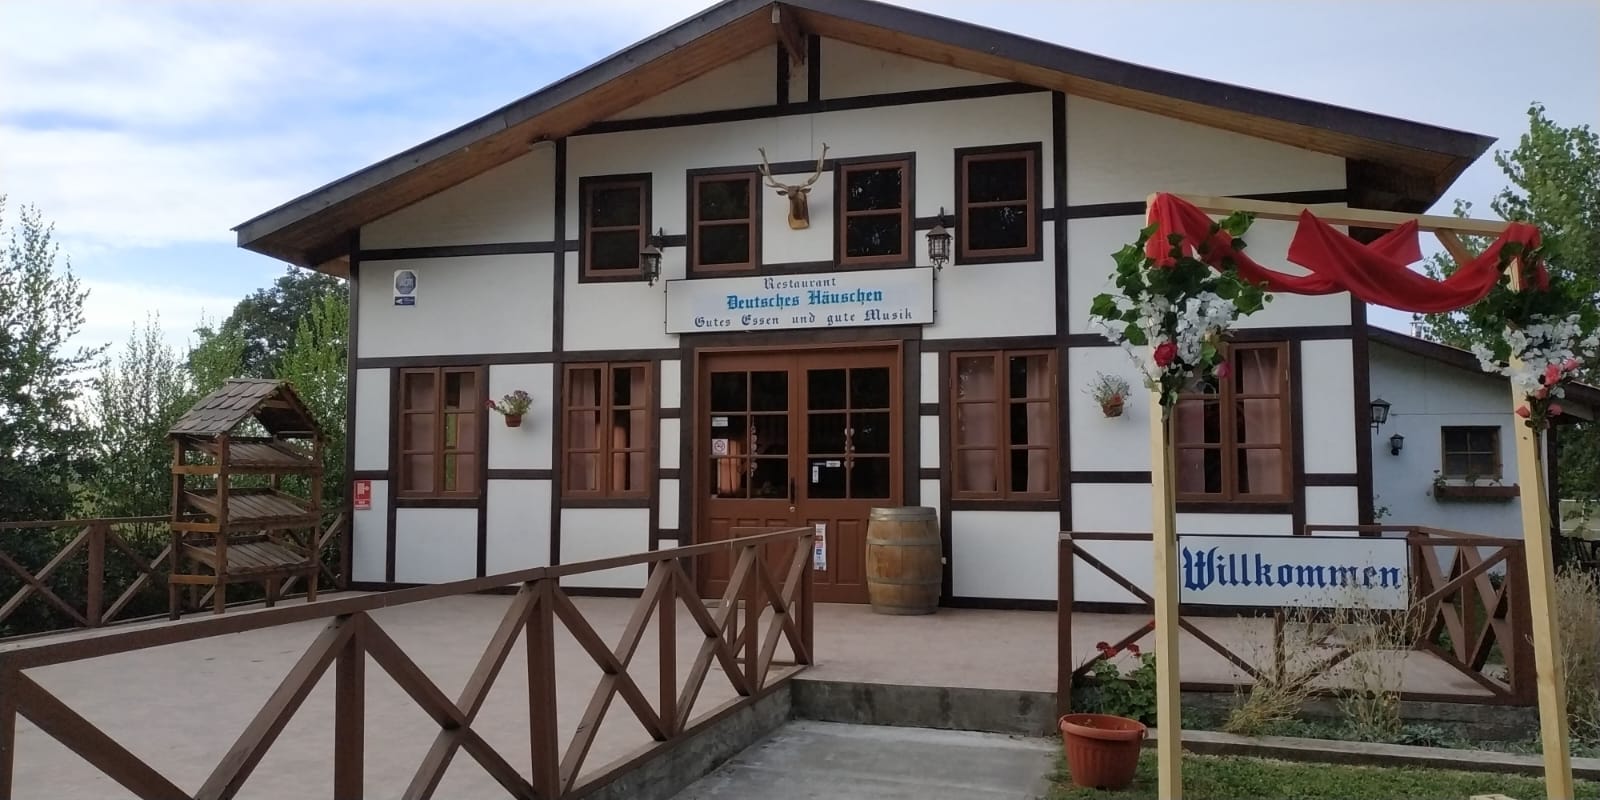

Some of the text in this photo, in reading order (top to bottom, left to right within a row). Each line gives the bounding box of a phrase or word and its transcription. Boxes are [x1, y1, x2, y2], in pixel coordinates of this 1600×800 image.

[764, 277, 836, 290] Restaurant
[726, 288, 883, 310] Deutsches Häuschen
[694, 308, 912, 328] Gutes Essen und gute Musik
[1182, 545, 1401, 591] Willkommen
